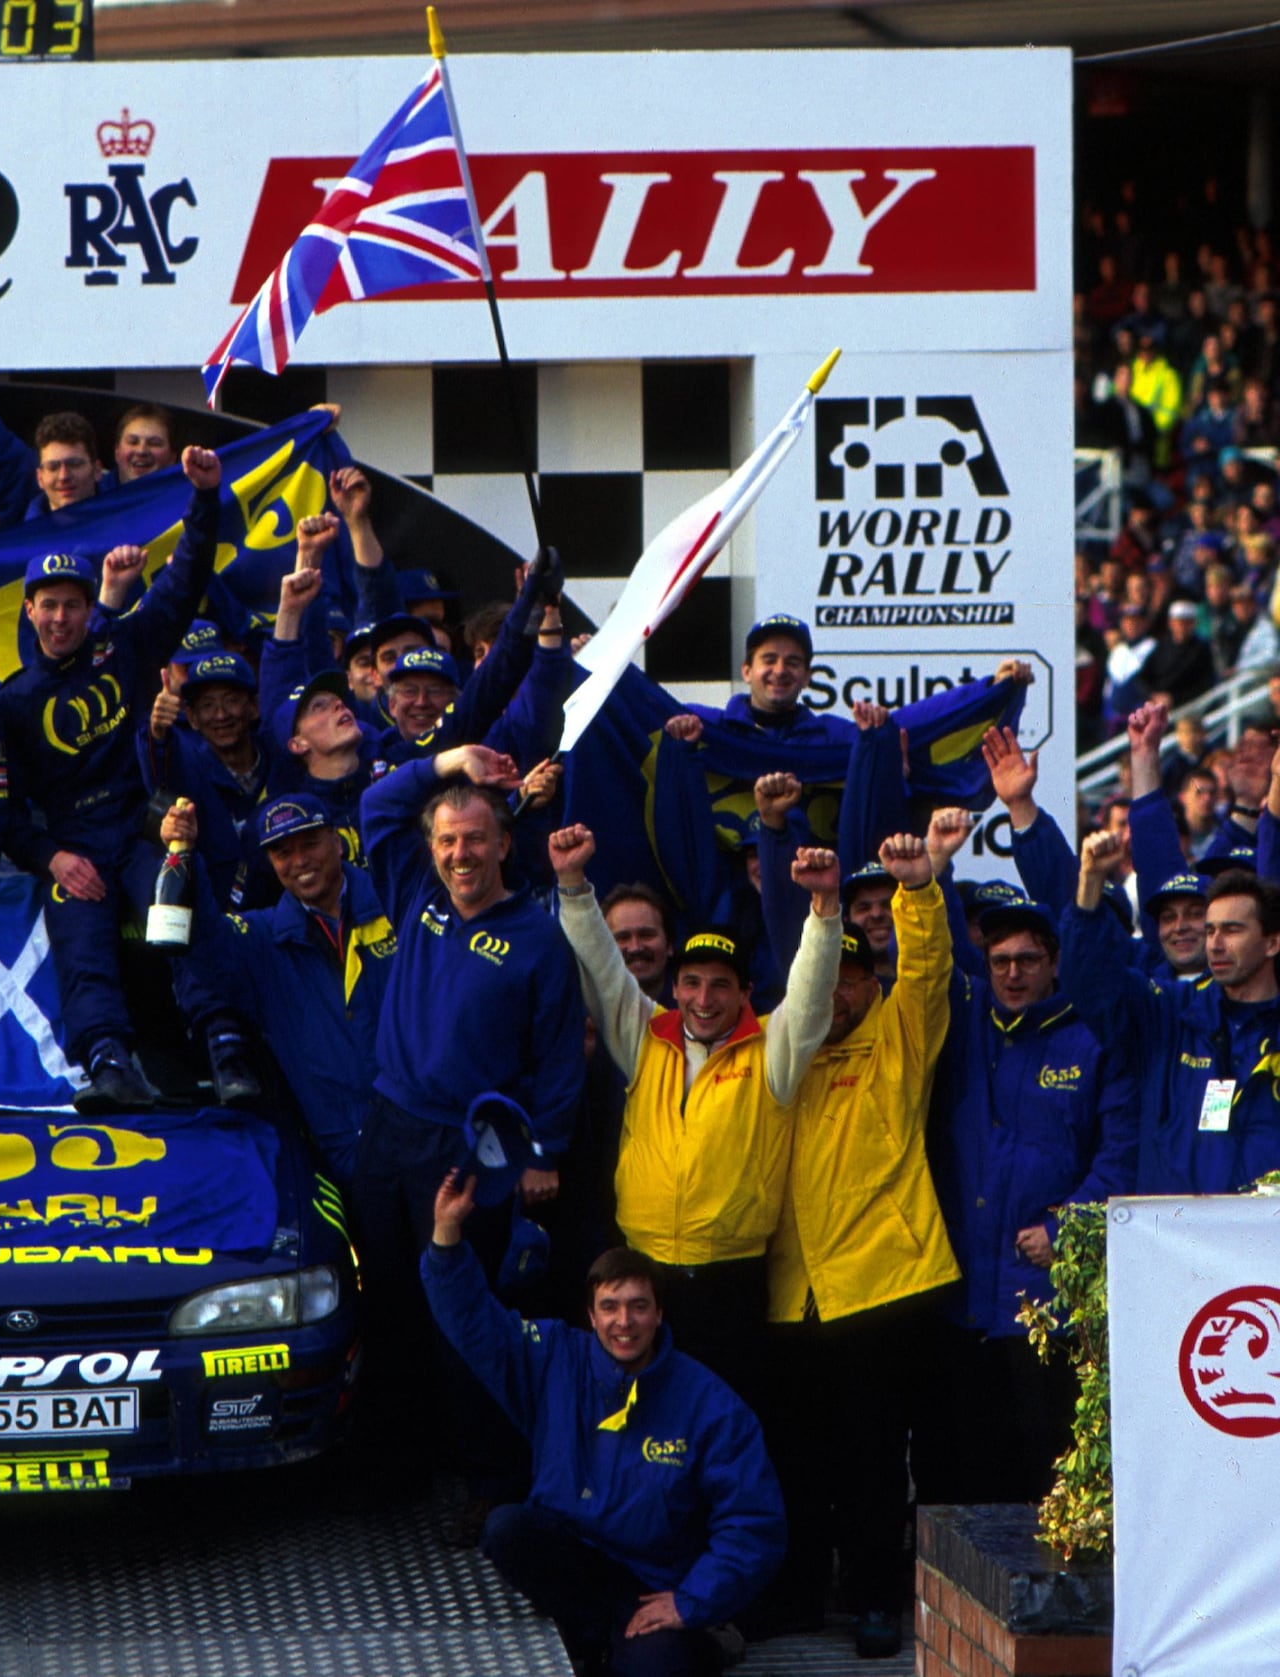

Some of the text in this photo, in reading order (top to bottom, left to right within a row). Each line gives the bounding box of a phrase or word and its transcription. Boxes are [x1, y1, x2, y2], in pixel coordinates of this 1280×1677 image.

[64, 164, 199, 286] RAC
[313, 168, 936, 282] ALLY
[818, 509, 1011, 548] WORLD
[818, 550, 1011, 596] RALLY
[820, 605, 1011, 625] CHAMPIONSHIP
[1045, 1064, 1081, 1083] 555
[201, 1343, 291, 1378] PIRELLI
[51, 1391, 132, 1430] BAT
[649, 1437, 687, 1456] 555
